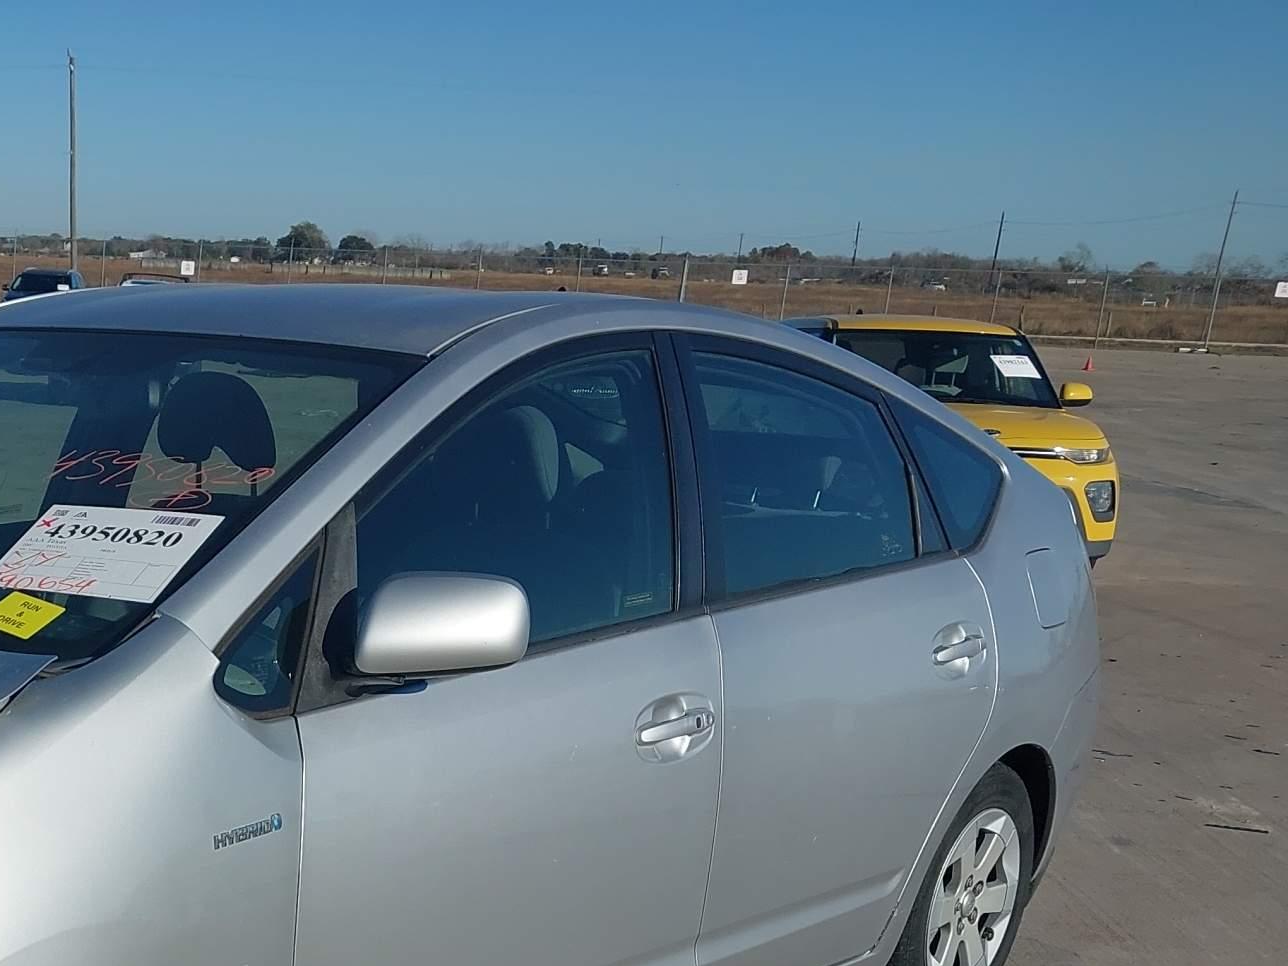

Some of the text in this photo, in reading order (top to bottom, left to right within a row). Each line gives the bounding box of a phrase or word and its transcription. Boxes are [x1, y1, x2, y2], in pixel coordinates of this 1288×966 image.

[44, 523, 184, 548] 43950820
[20, 600, 42, 612] RUN
[213, 813, 282, 850] HYBRID
